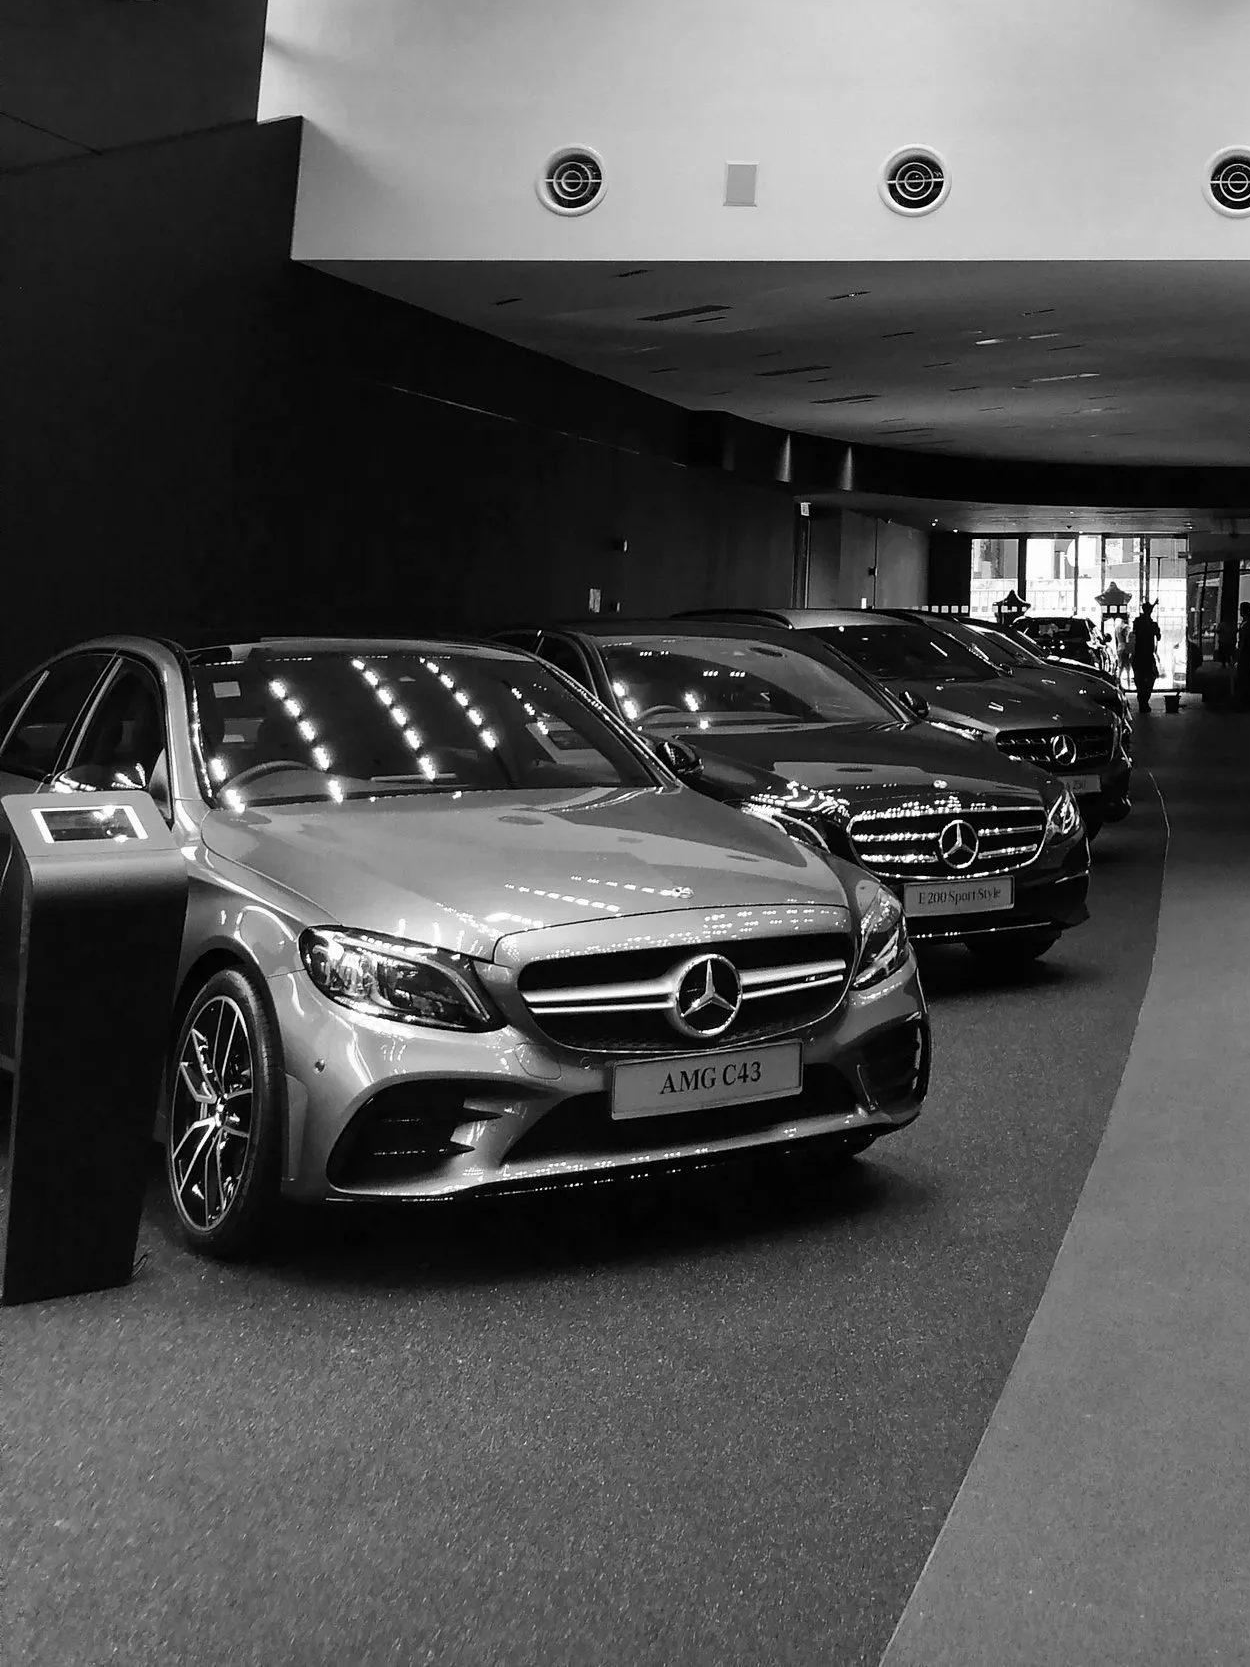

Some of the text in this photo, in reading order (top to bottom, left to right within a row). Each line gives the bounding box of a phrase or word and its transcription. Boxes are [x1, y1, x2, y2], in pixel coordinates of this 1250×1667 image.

[928, 891, 947, 904] 200
[949, 890, 976, 905] Sport
[978, 887, 1001, 901] Style
[660, 1061, 761, 1095] AMG C43
